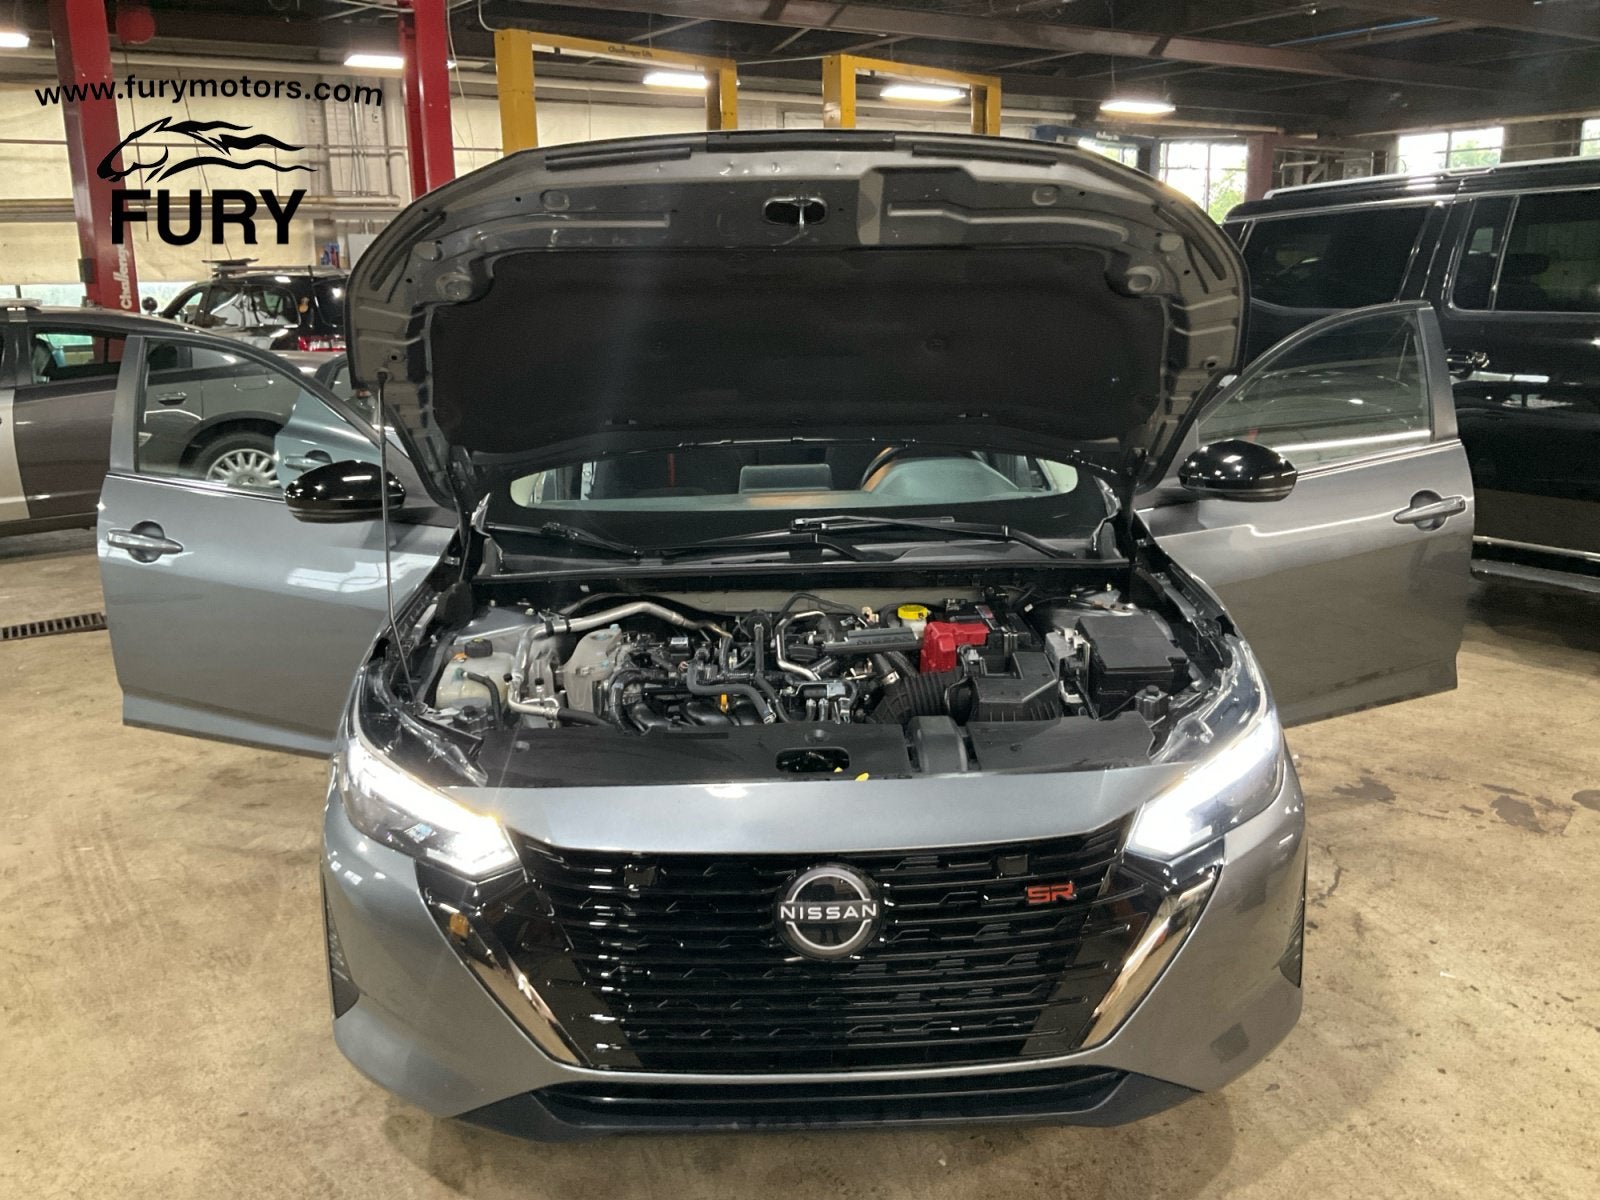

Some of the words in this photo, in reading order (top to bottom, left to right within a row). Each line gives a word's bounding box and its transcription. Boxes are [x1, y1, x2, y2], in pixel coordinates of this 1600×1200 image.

[113, 240, 132, 310] Challeng
[1027, 883, 1074, 904] SR
[780, 903, 877, 920] NISSAN
